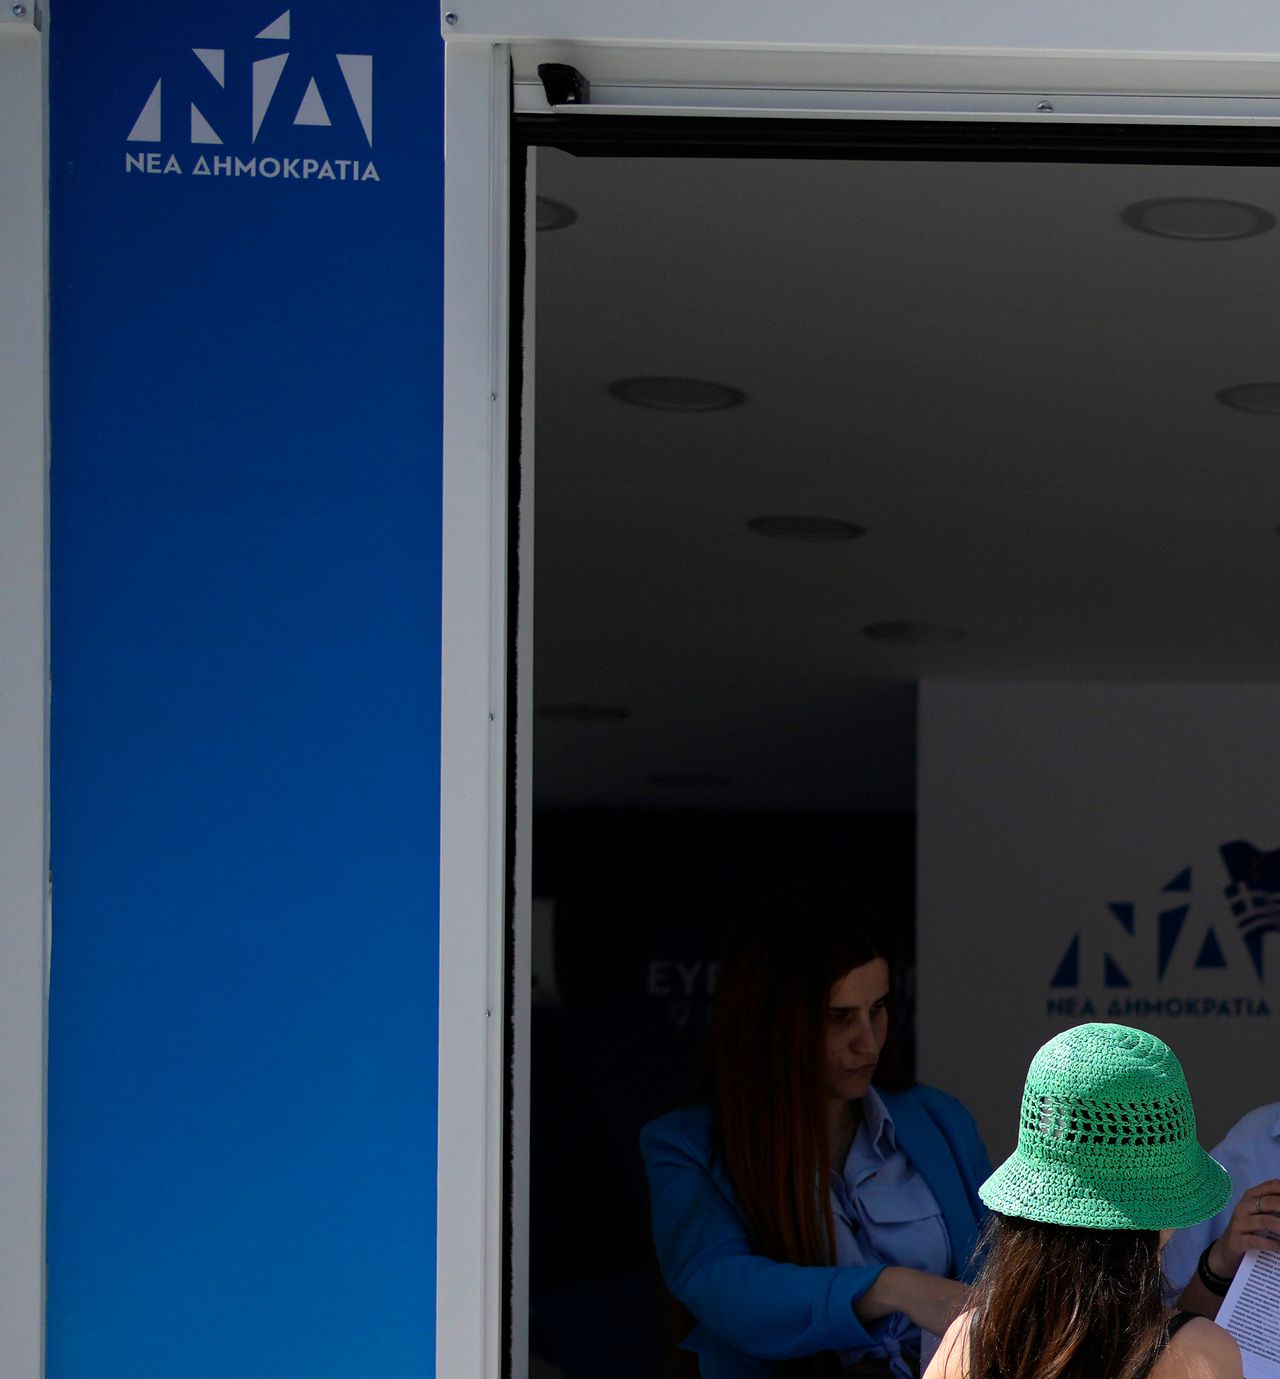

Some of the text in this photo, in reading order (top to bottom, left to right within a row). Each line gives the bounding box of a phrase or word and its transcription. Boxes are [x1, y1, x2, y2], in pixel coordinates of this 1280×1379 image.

[125, 152, 381, 182] ΝΕΑ ΔΗΜΟΚΡΑΤΙΑ
[1046, 997, 1271, 1018] ΝΕΑ ΔΗΜΟΚΡΑΤΙΑ
